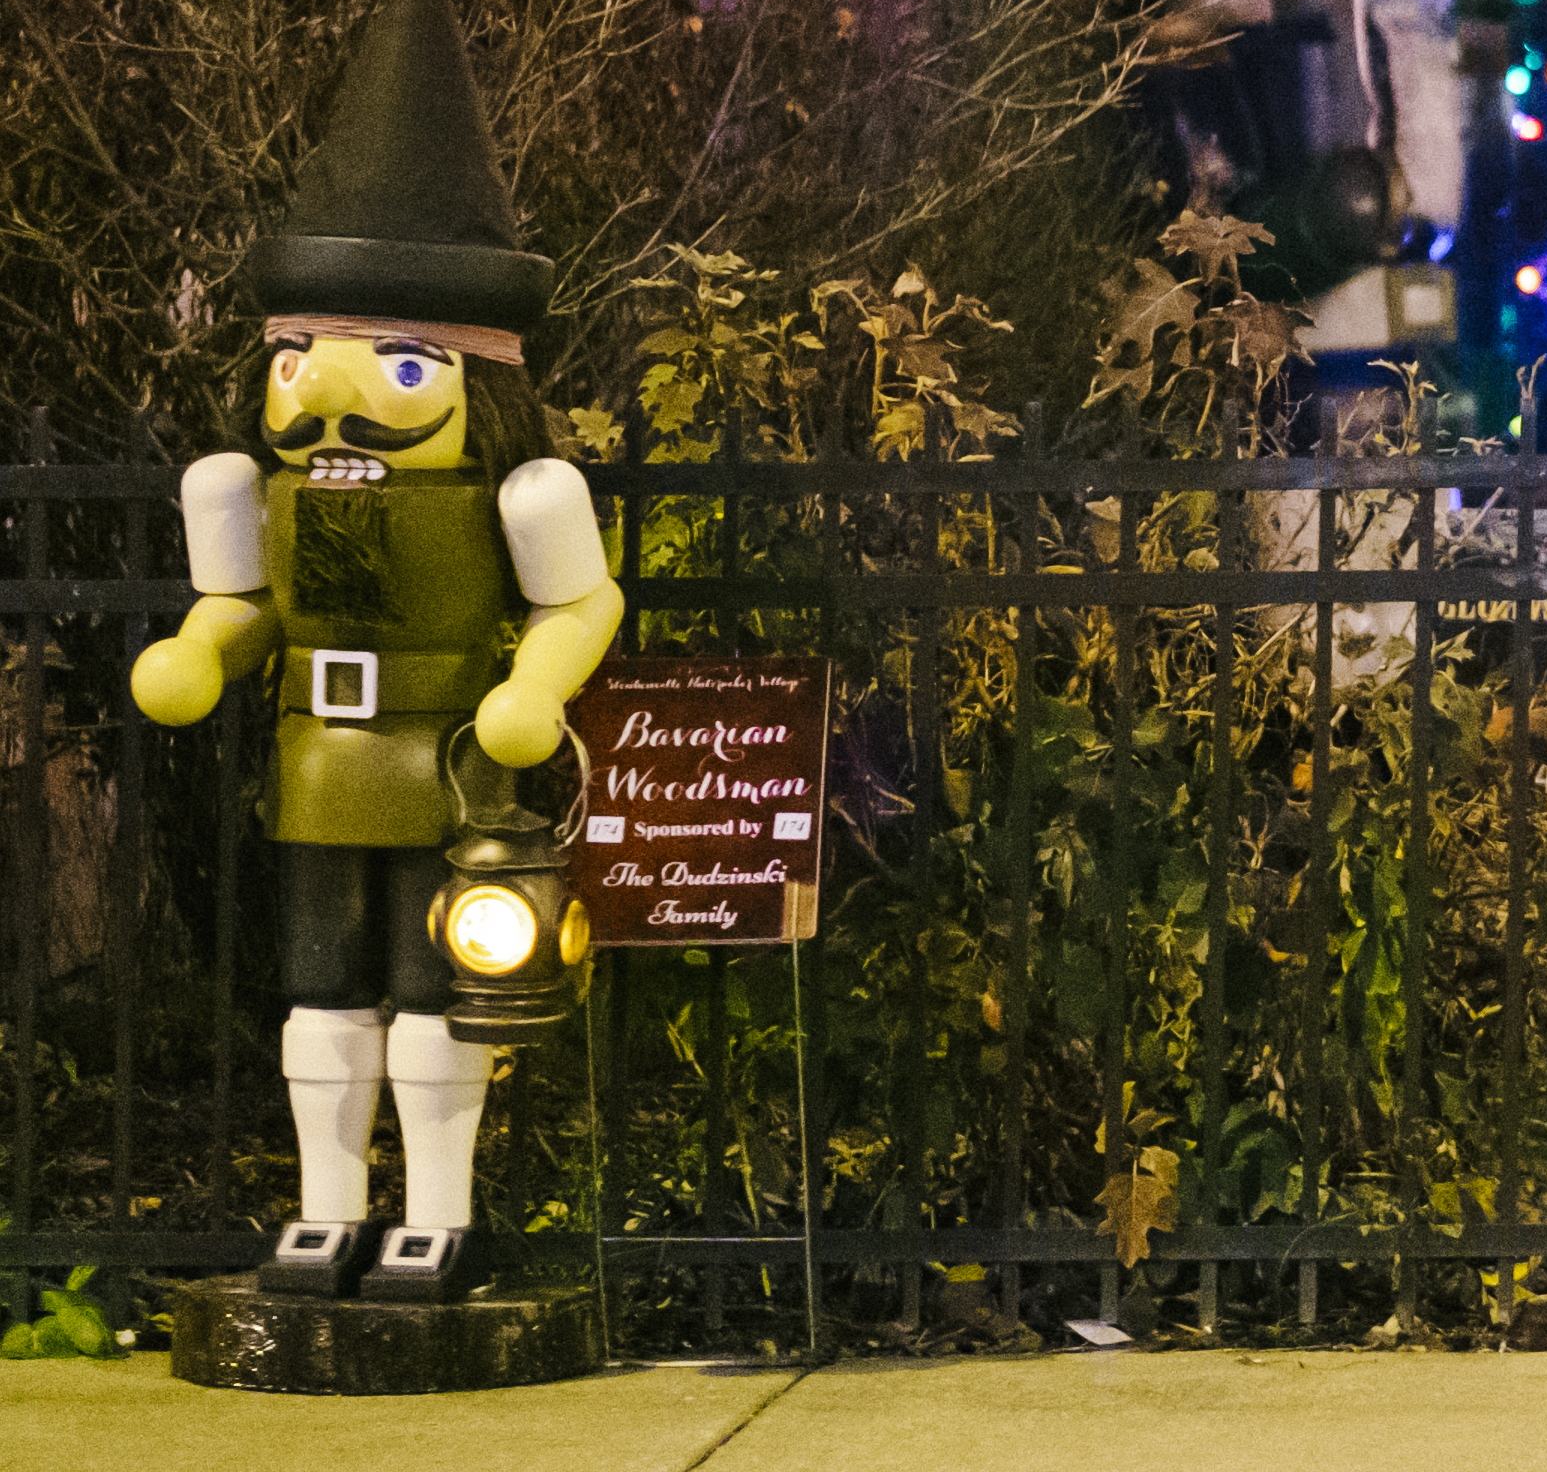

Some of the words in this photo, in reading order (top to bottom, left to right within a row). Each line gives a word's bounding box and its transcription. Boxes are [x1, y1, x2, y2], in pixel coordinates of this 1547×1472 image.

[609, 711, 794, 763] Bavarian
[592, 764, 812, 805] Woodsman
[633, 819, 734, 841] Sponsored
[739, 819, 763, 838] by
[602, 862, 654, 887] The
[661, 859, 789, 887] Dudzinski
[647, 899, 738, 930] Family
